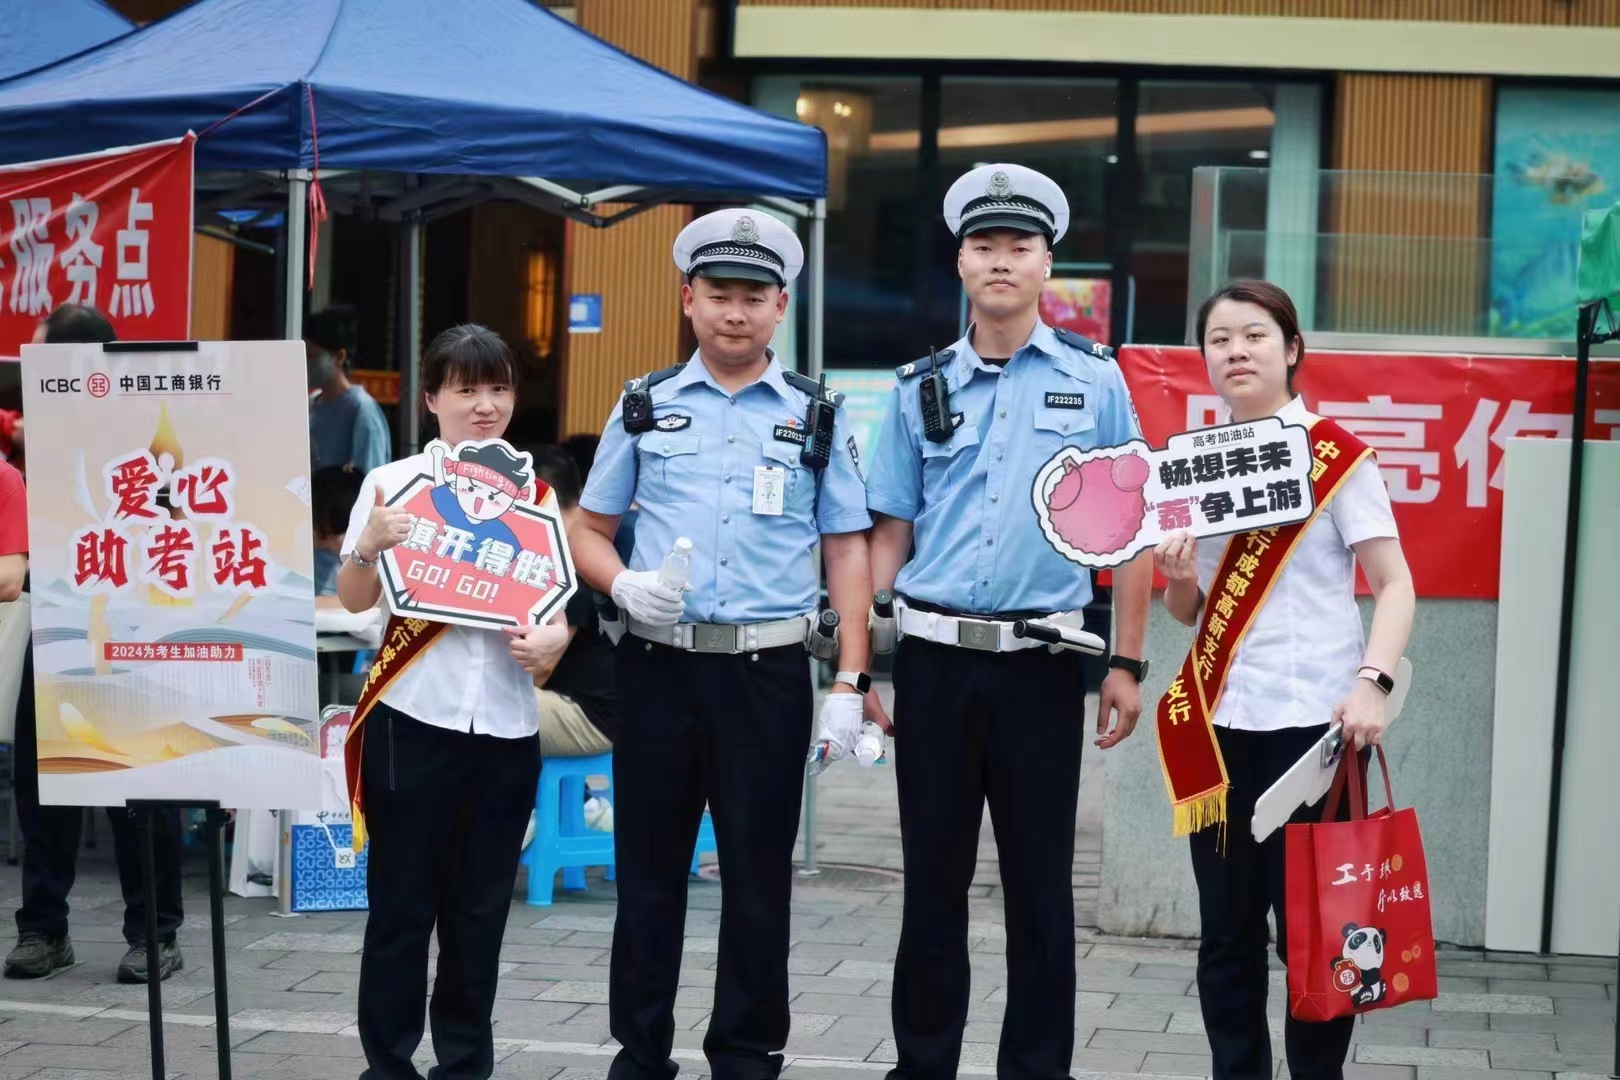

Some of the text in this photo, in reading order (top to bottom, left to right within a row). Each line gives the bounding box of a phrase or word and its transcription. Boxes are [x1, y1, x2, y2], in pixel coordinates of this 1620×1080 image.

[0, 187, 155, 318] 服务点
[40, 377, 82, 393] ICBC
[119, 374, 222, 392] 中国工商银行
[1047, 395, 1083, 405] JF222235
[1191, 426, 1256, 448] 高考加油站
[111, 455, 229, 520] 爱心
[1158, 440, 1292, 490] 畅想未来
[74, 525, 268, 591] 助考站
[406, 559, 500, 605] GO! GO!
[1196, 527, 1279, 681] 行成都高新支行
[111, 645, 236, 661] 2024为考生加油助力
